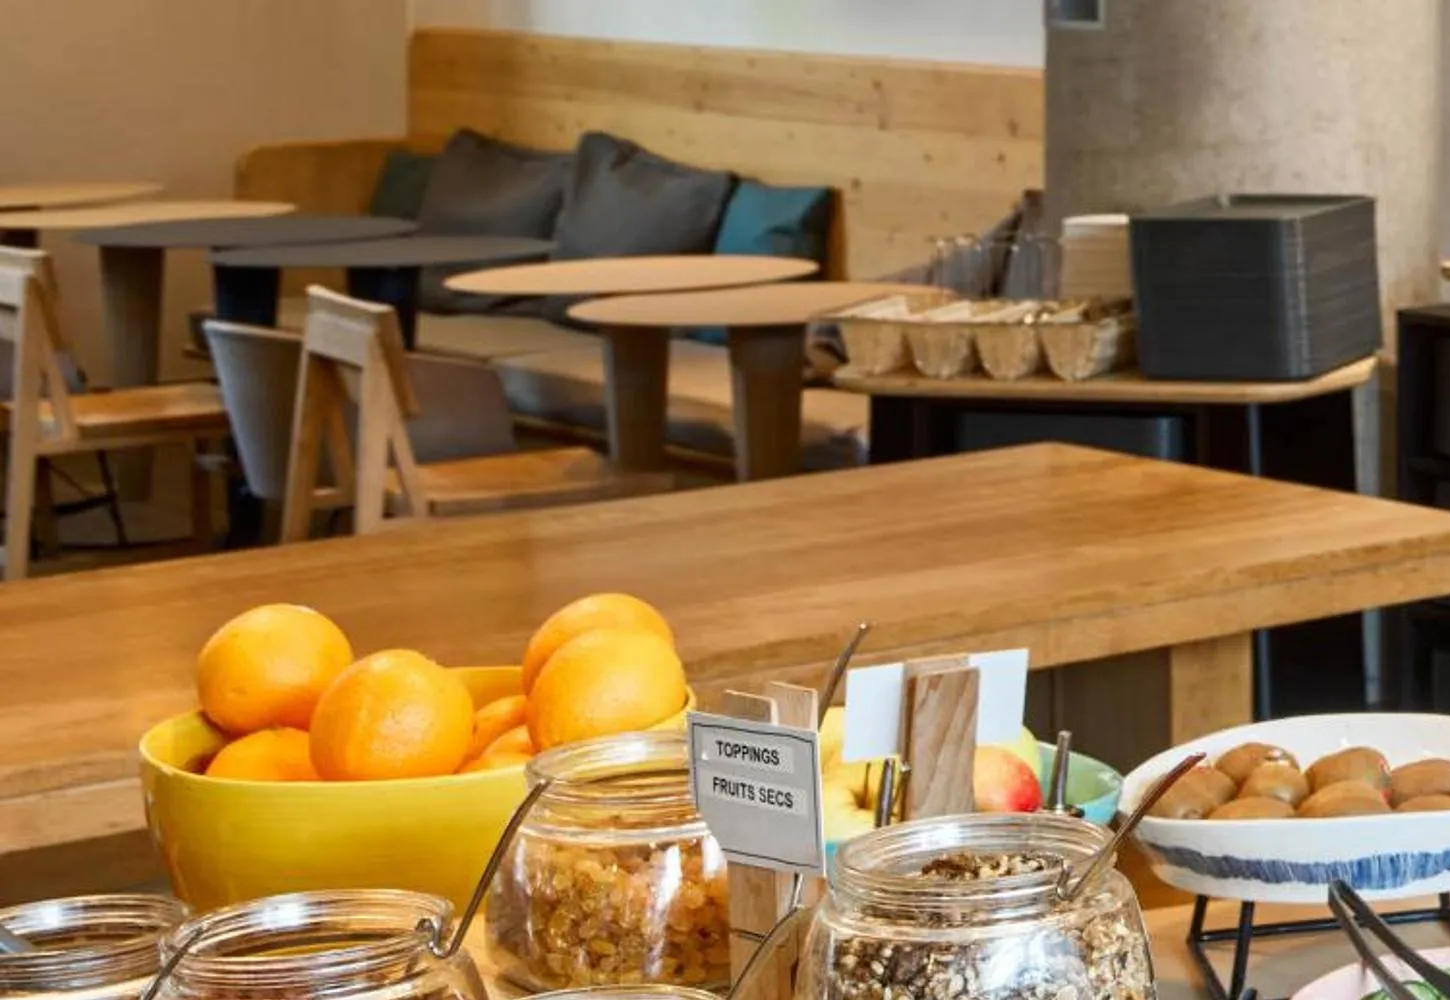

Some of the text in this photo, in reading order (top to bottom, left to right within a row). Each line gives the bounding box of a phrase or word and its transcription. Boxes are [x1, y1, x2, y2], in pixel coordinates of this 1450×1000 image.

[715, 740, 780, 766] TOPPINGS
[713, 776, 794, 809] FRUITS SECS
